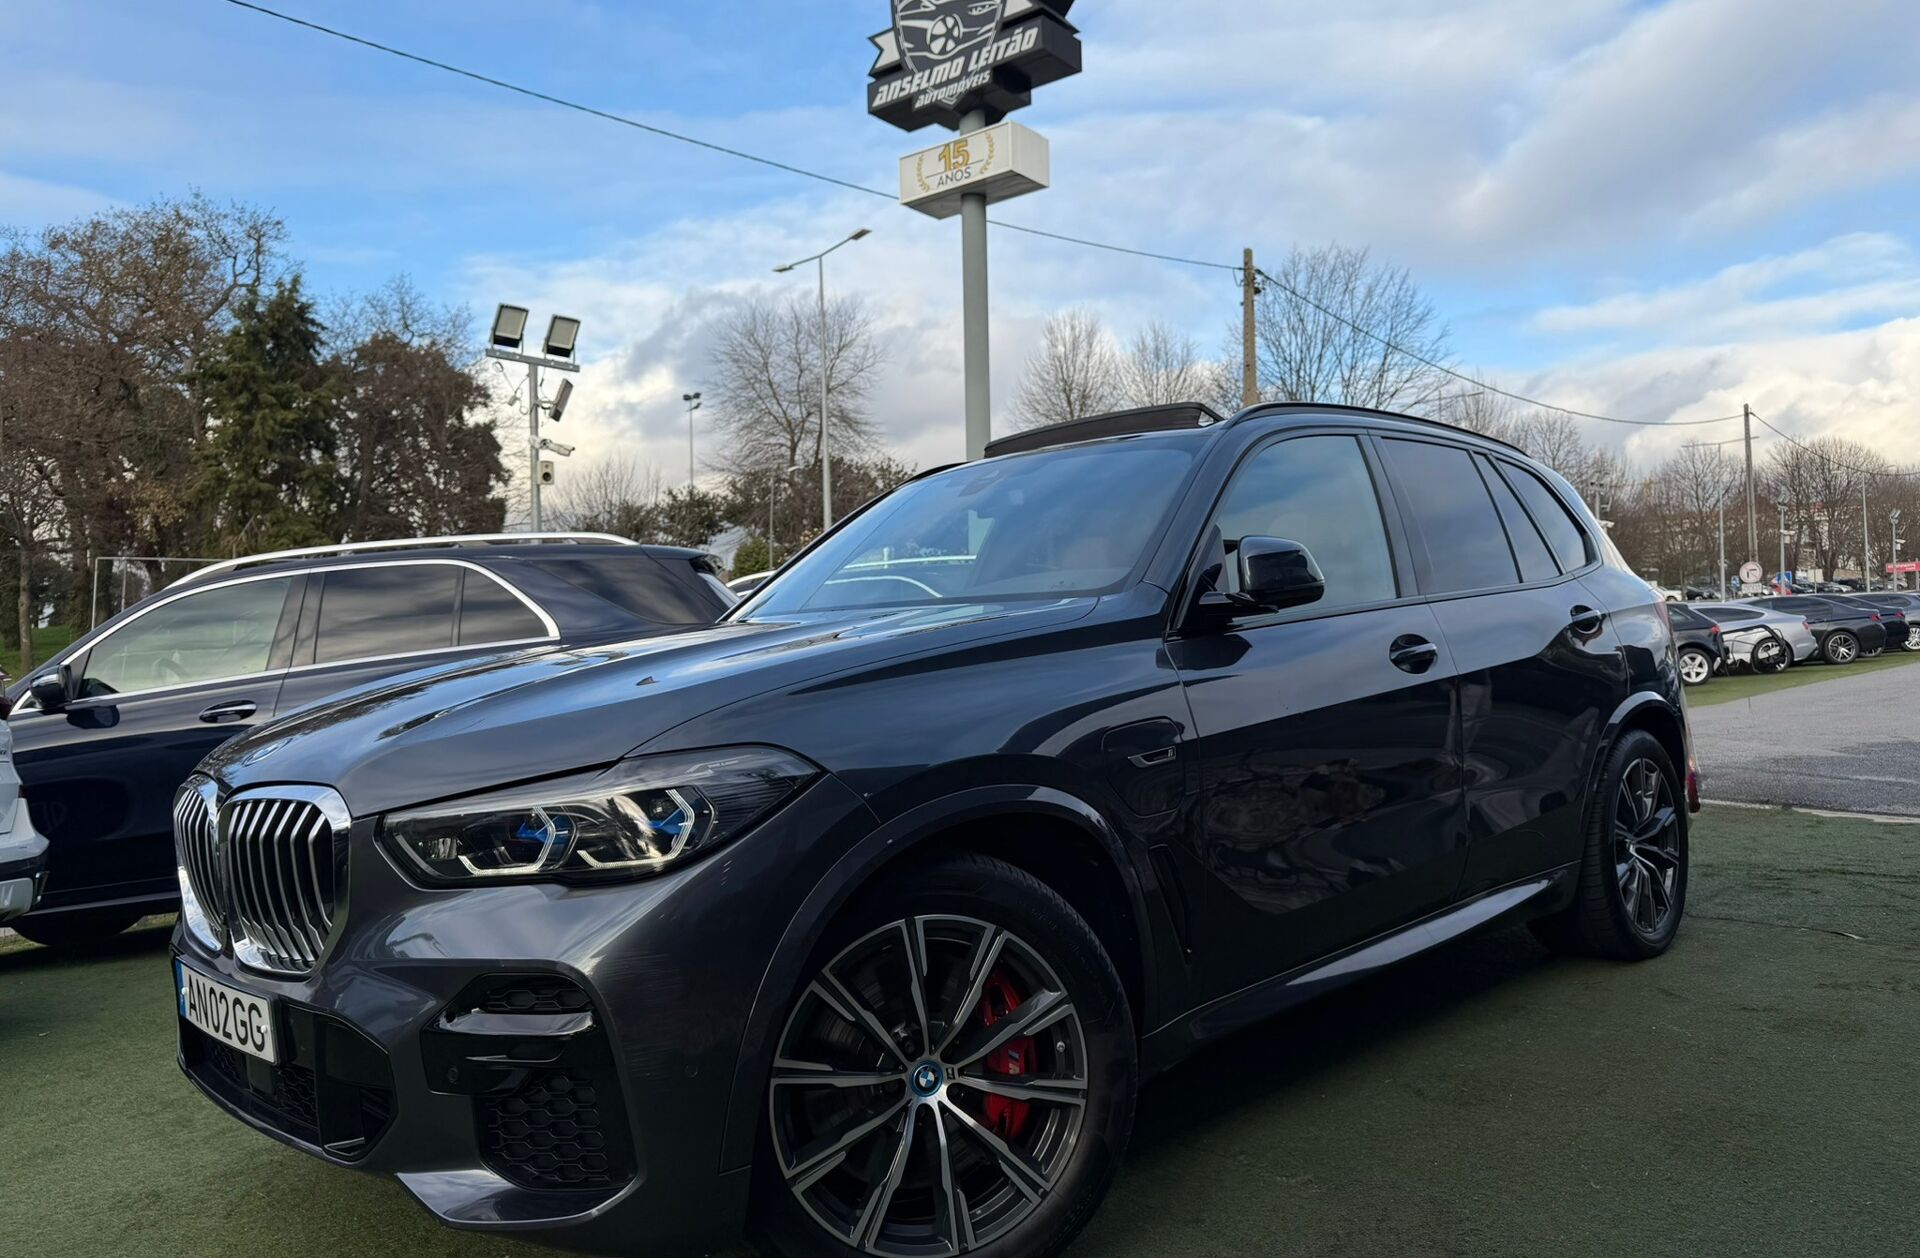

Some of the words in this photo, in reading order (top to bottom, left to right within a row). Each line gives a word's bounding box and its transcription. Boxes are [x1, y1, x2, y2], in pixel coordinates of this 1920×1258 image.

[968, 27, 1039, 72] LEITÃO
[938, 140, 970, 172] 15
[936, 168, 972, 188] ANOS
